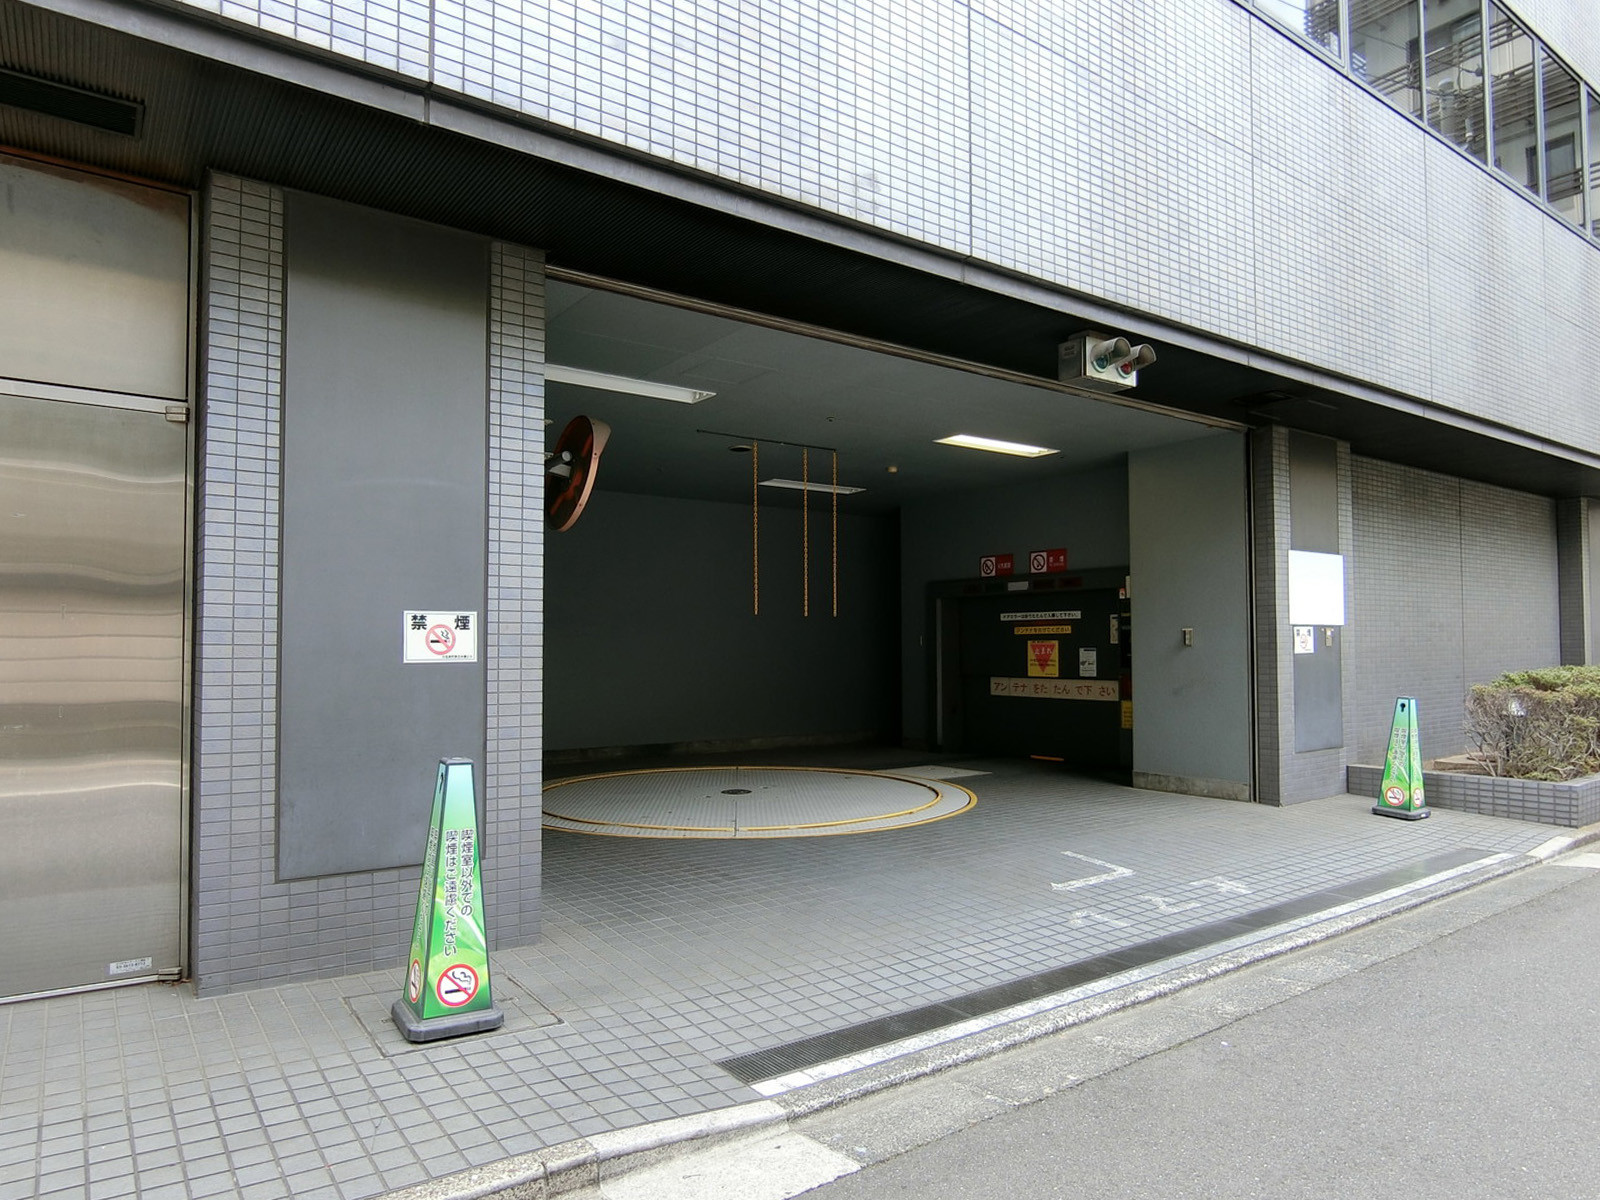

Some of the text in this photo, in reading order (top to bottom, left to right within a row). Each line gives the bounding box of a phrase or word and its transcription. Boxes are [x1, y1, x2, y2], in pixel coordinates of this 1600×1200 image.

[994, 683, 1115, 696] アンテナをたたんで下さい
[444, 830, 458, 957] 喫煙はご遠慮ください
[461, 829, 473, 916] 喫煙室以外での
